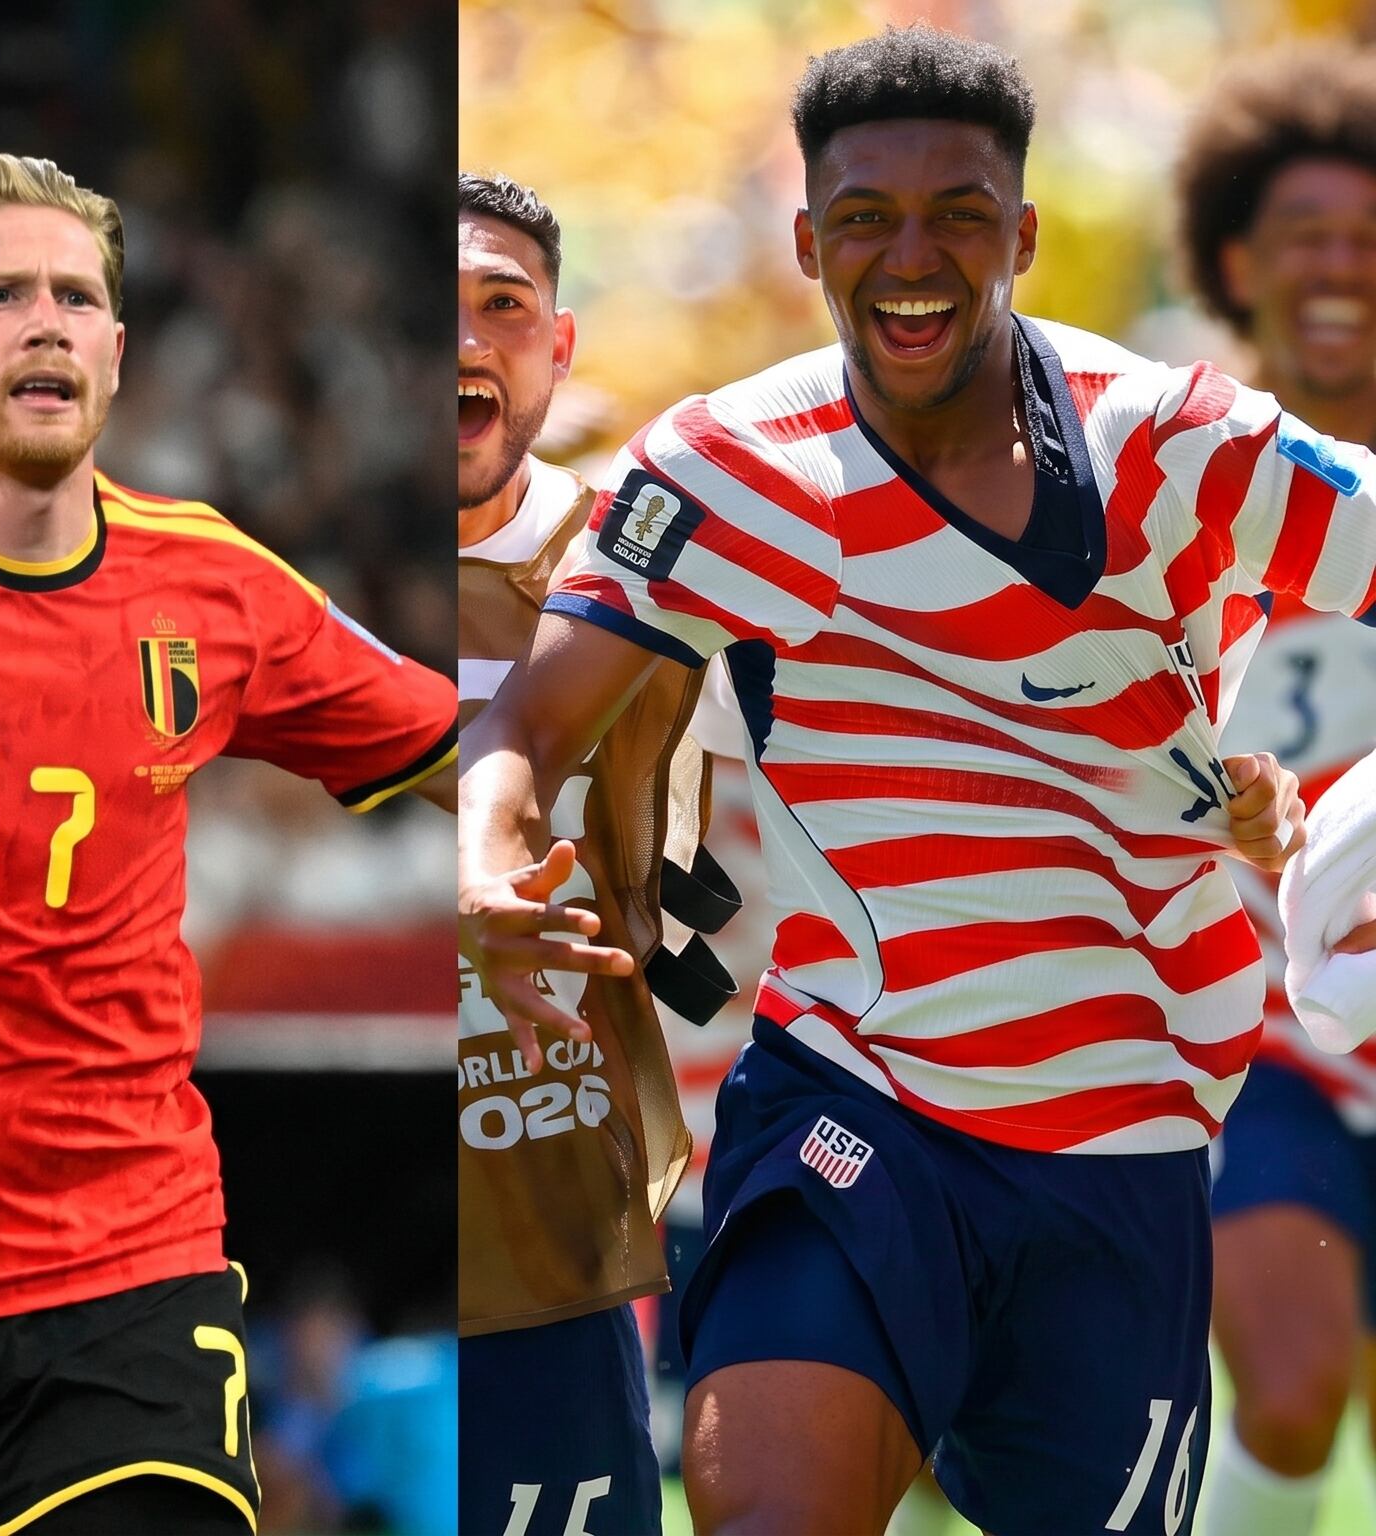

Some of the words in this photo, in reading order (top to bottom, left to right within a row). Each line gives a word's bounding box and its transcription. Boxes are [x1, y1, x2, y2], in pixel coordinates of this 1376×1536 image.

[1279, 652, 1322, 760] 3
[29, 766, 96, 909] 7
[816, 1120, 870, 1162] USA
[193, 1324, 247, 1458] 7
[1104, 1398, 1198, 1536] 16
